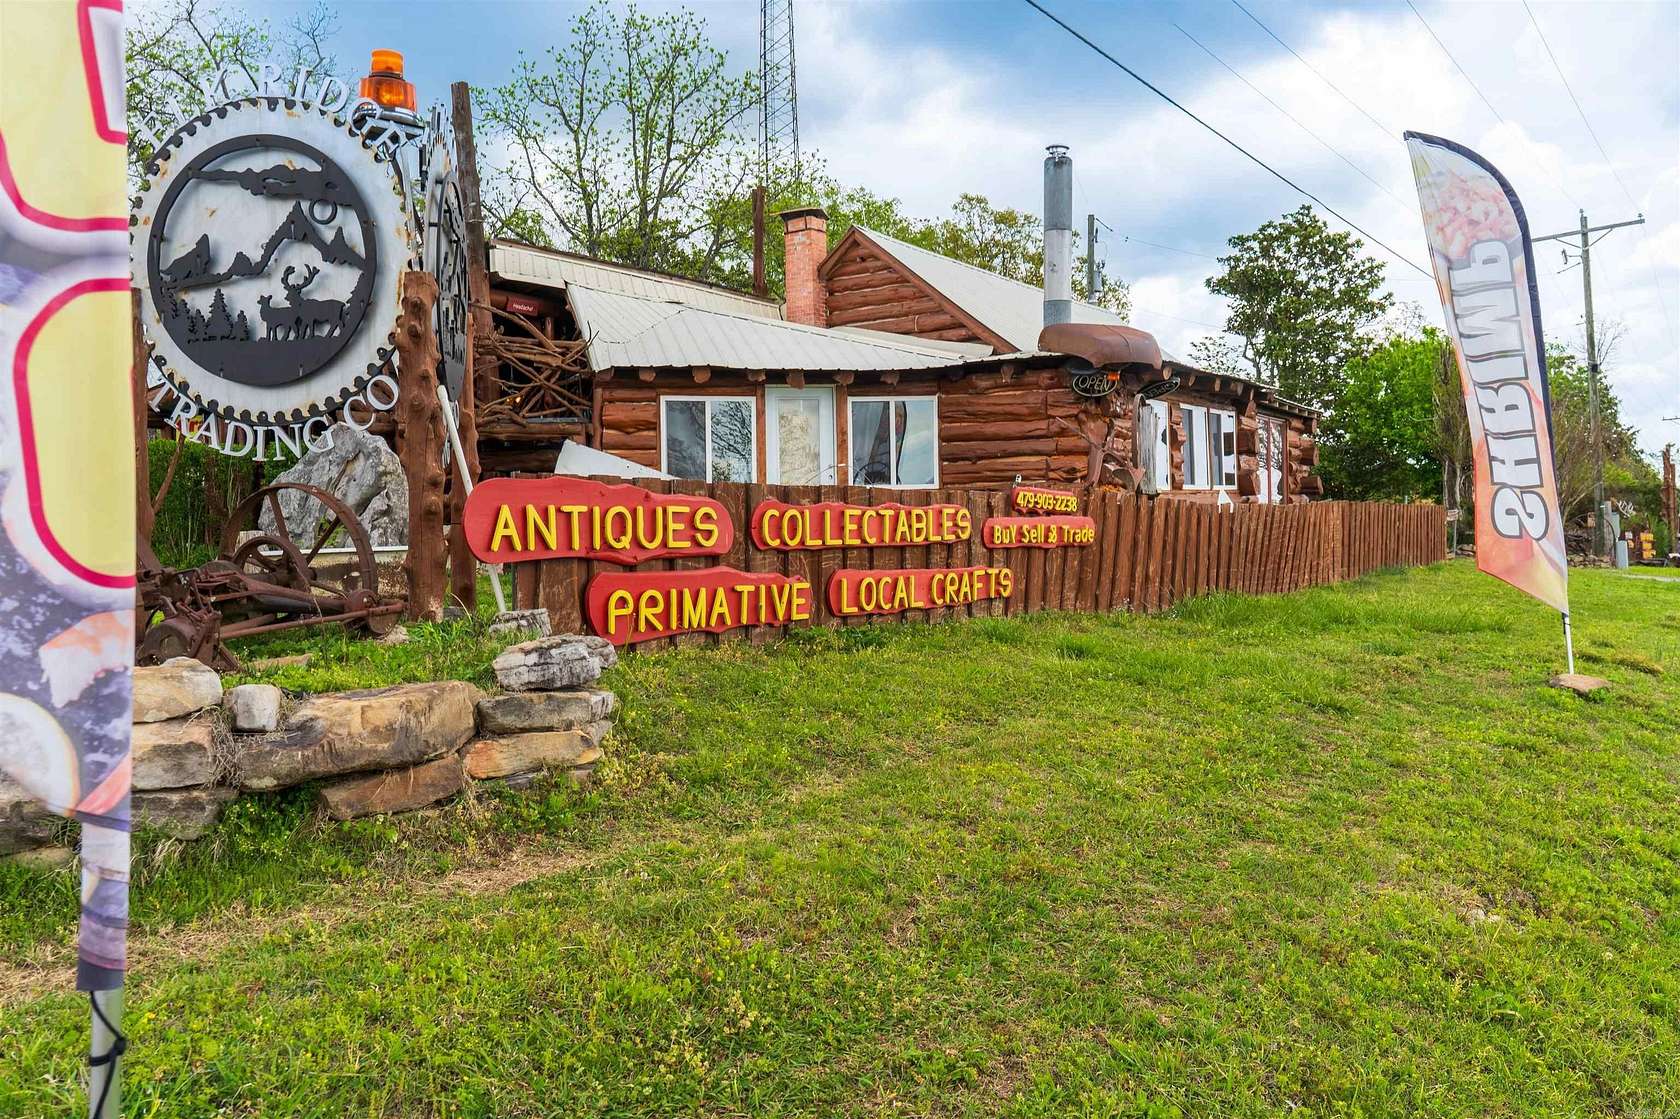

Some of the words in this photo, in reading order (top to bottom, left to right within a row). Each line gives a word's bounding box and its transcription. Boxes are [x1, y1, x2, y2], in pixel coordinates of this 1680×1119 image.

[257, 63, 408, 160] RIDGE
[1078, 375, 1111, 391] OPEN
[148, 373, 335, 461] TRADING
[344, 375, 399, 431] CO
[491, 504, 719, 552] ANTIQUES
[762, 508, 972, 546] COLLECTABLES
[1021, 523, 1045, 544] Sell
[1048, 524, 1058, 544] &
[1062, 524, 1096, 544] Trade
[608, 582, 811, 635] PRIMATIVE
[841, 574, 926, 613] LOCAL
[931, 568, 1013, 606] CRAFTS
